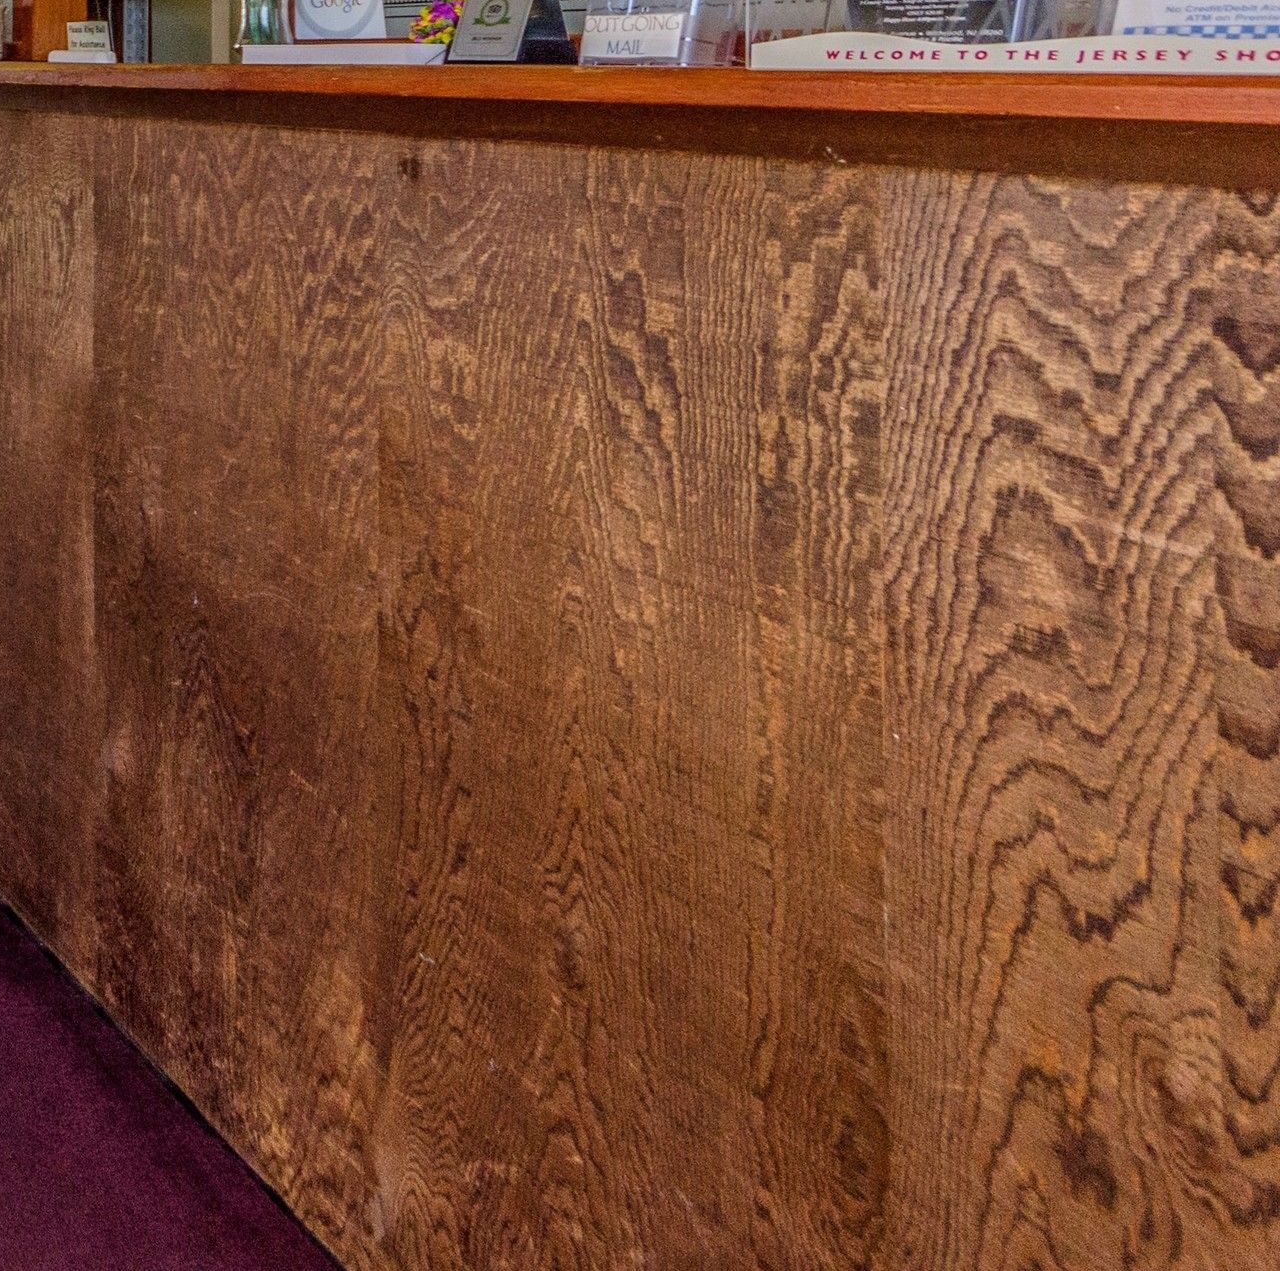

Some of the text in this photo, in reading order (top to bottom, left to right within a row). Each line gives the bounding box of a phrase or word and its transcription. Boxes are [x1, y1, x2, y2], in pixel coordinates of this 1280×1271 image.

[584, 15, 680, 33] OUTGOING
[1185, 14, 1212, 22] ATM
[606, 39, 645, 55] MAIL
[826, 49, 942, 62] WELCOME
[957, 49, 989, 62] TO
[1006, 49, 1060, 62] THE
[1076, 49, 1193, 64] JERSEY
